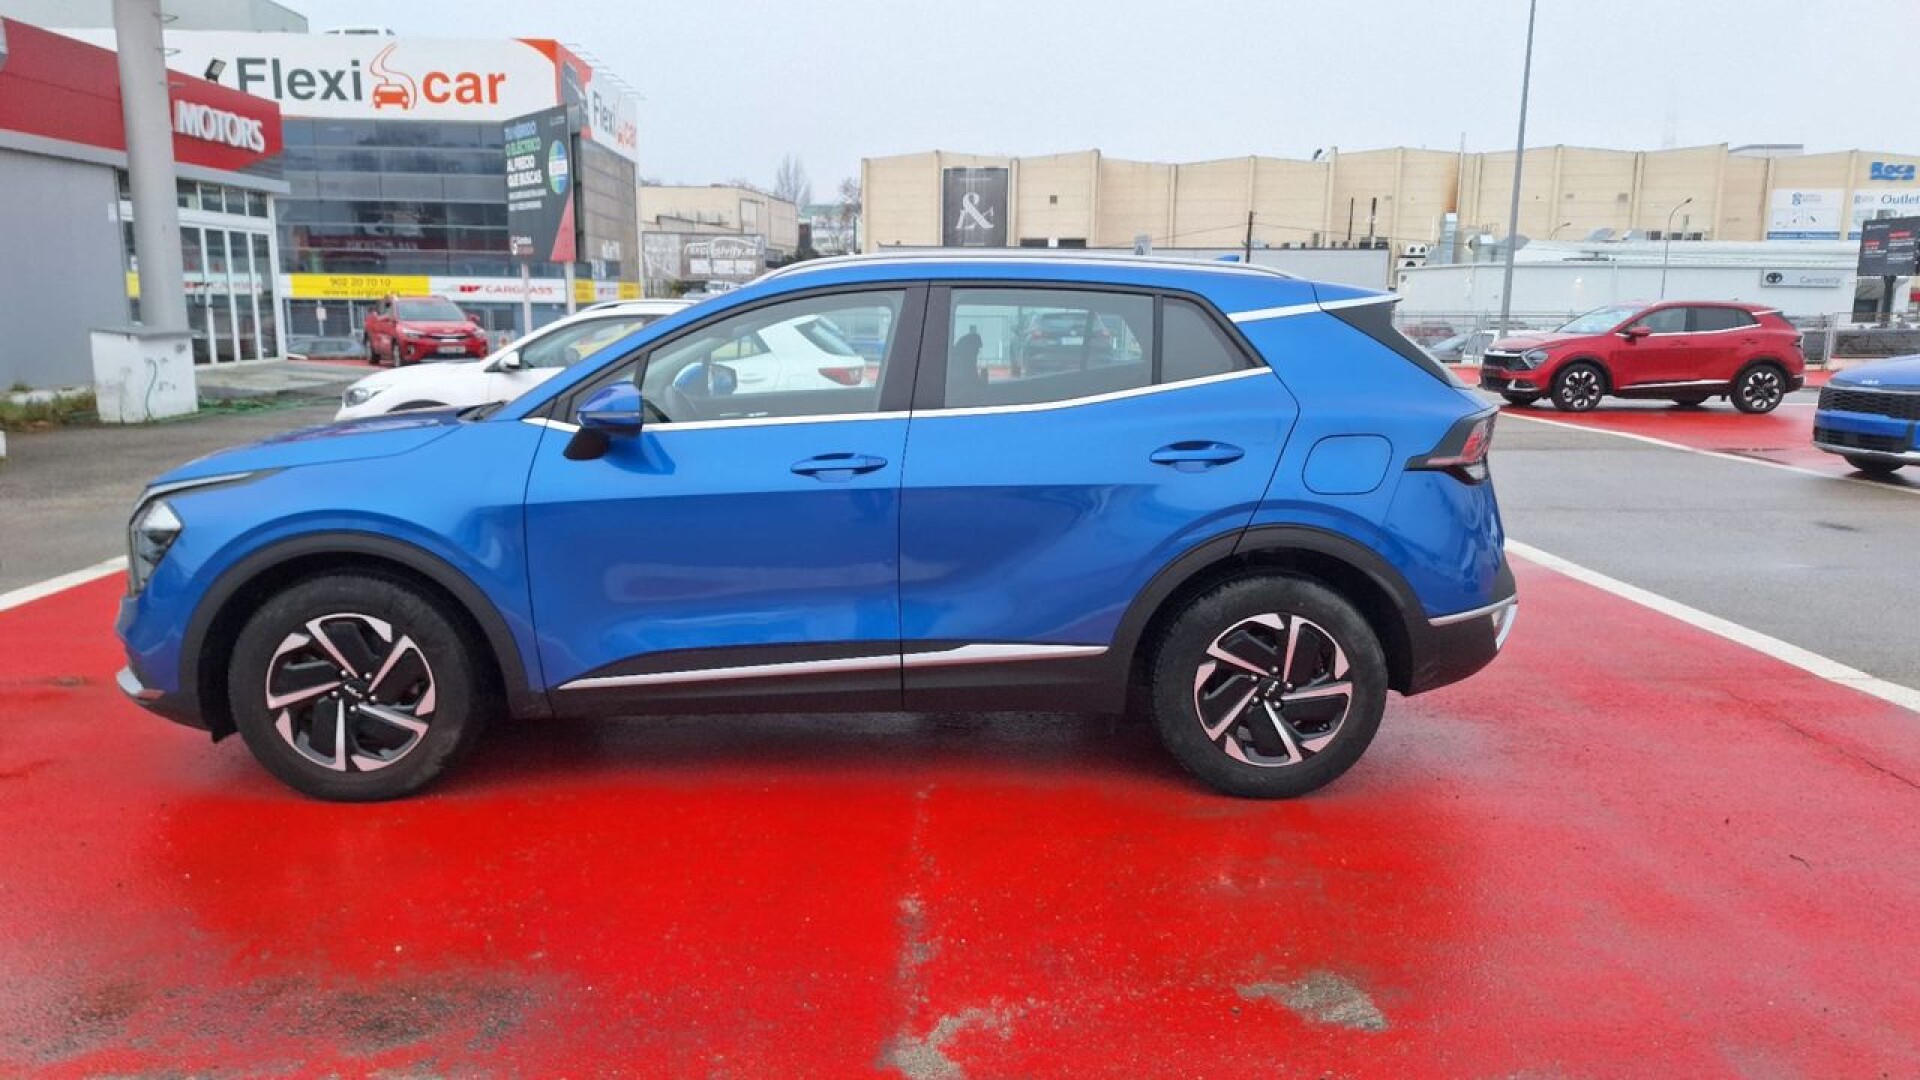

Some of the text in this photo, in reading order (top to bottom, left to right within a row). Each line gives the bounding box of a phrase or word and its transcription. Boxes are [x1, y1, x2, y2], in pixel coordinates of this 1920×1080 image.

[236, 57, 506, 105] Flexi car
[176, 100, 265, 153] MOTORS
[1870, 161, 1915, 180] Roca
[1880, 193, 1920, 205] Outlet
[485, 284, 554, 295] CARGASS
